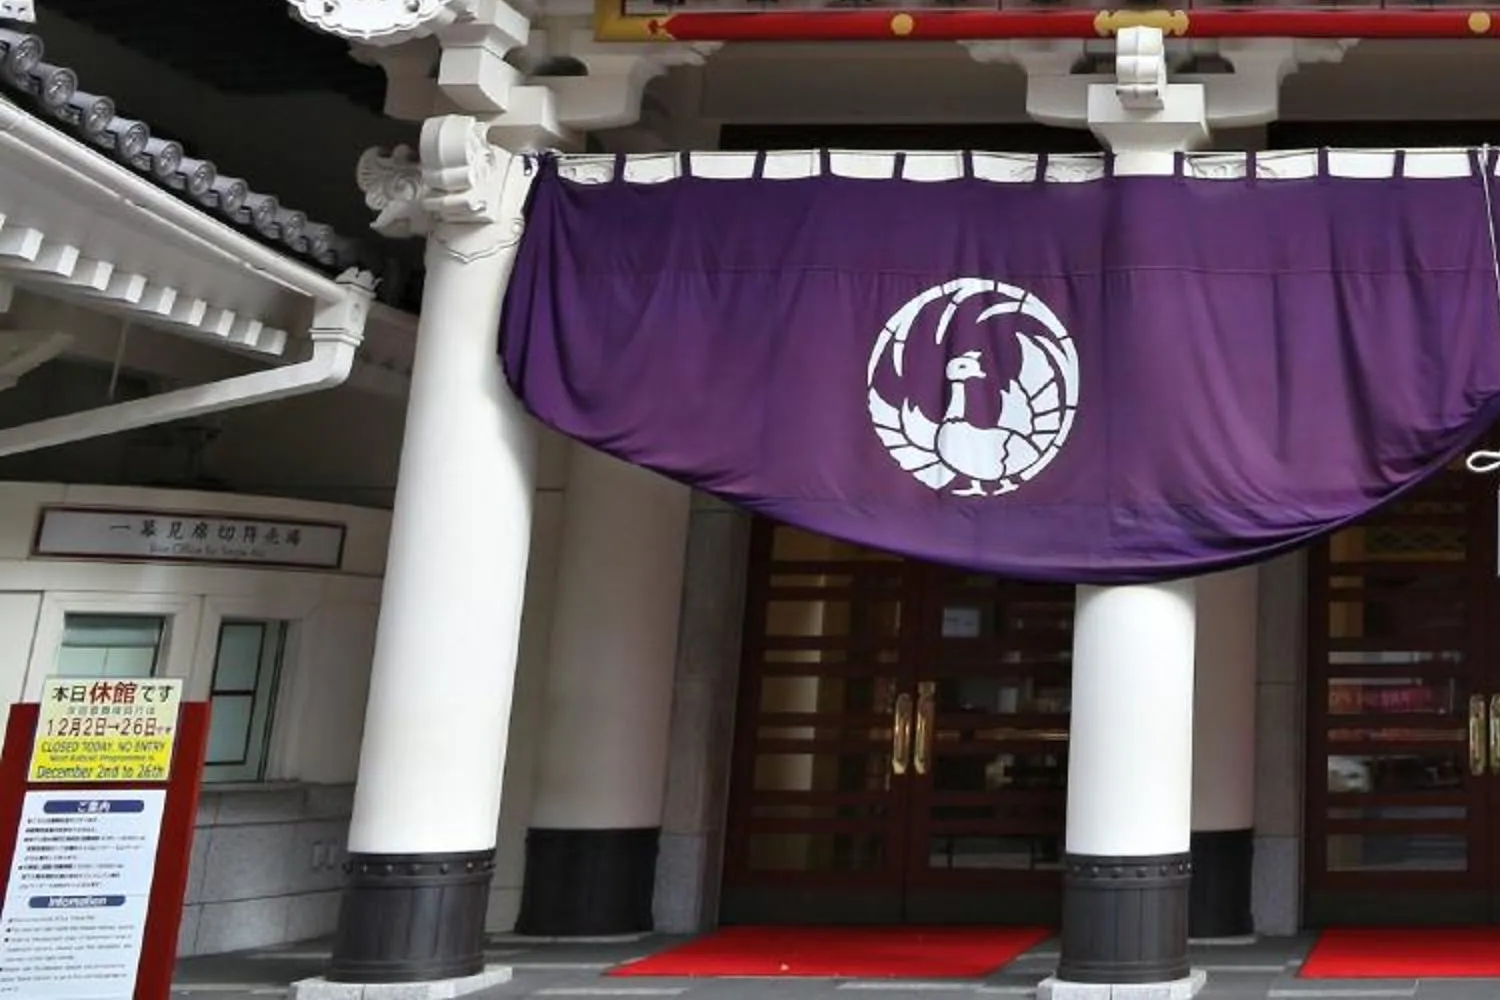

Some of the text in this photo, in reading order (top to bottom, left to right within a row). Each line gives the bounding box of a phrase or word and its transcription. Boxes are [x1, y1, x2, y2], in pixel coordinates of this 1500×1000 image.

[52, 682, 174, 704] 本日休館です
[41, 740, 79, 753] CLOSED
[118, 740, 133, 752] NO
[135, 740, 166, 752] ENTRY
[37, 764, 164, 779] December 2nd to 26th
[48, 895, 107, 908] Information
